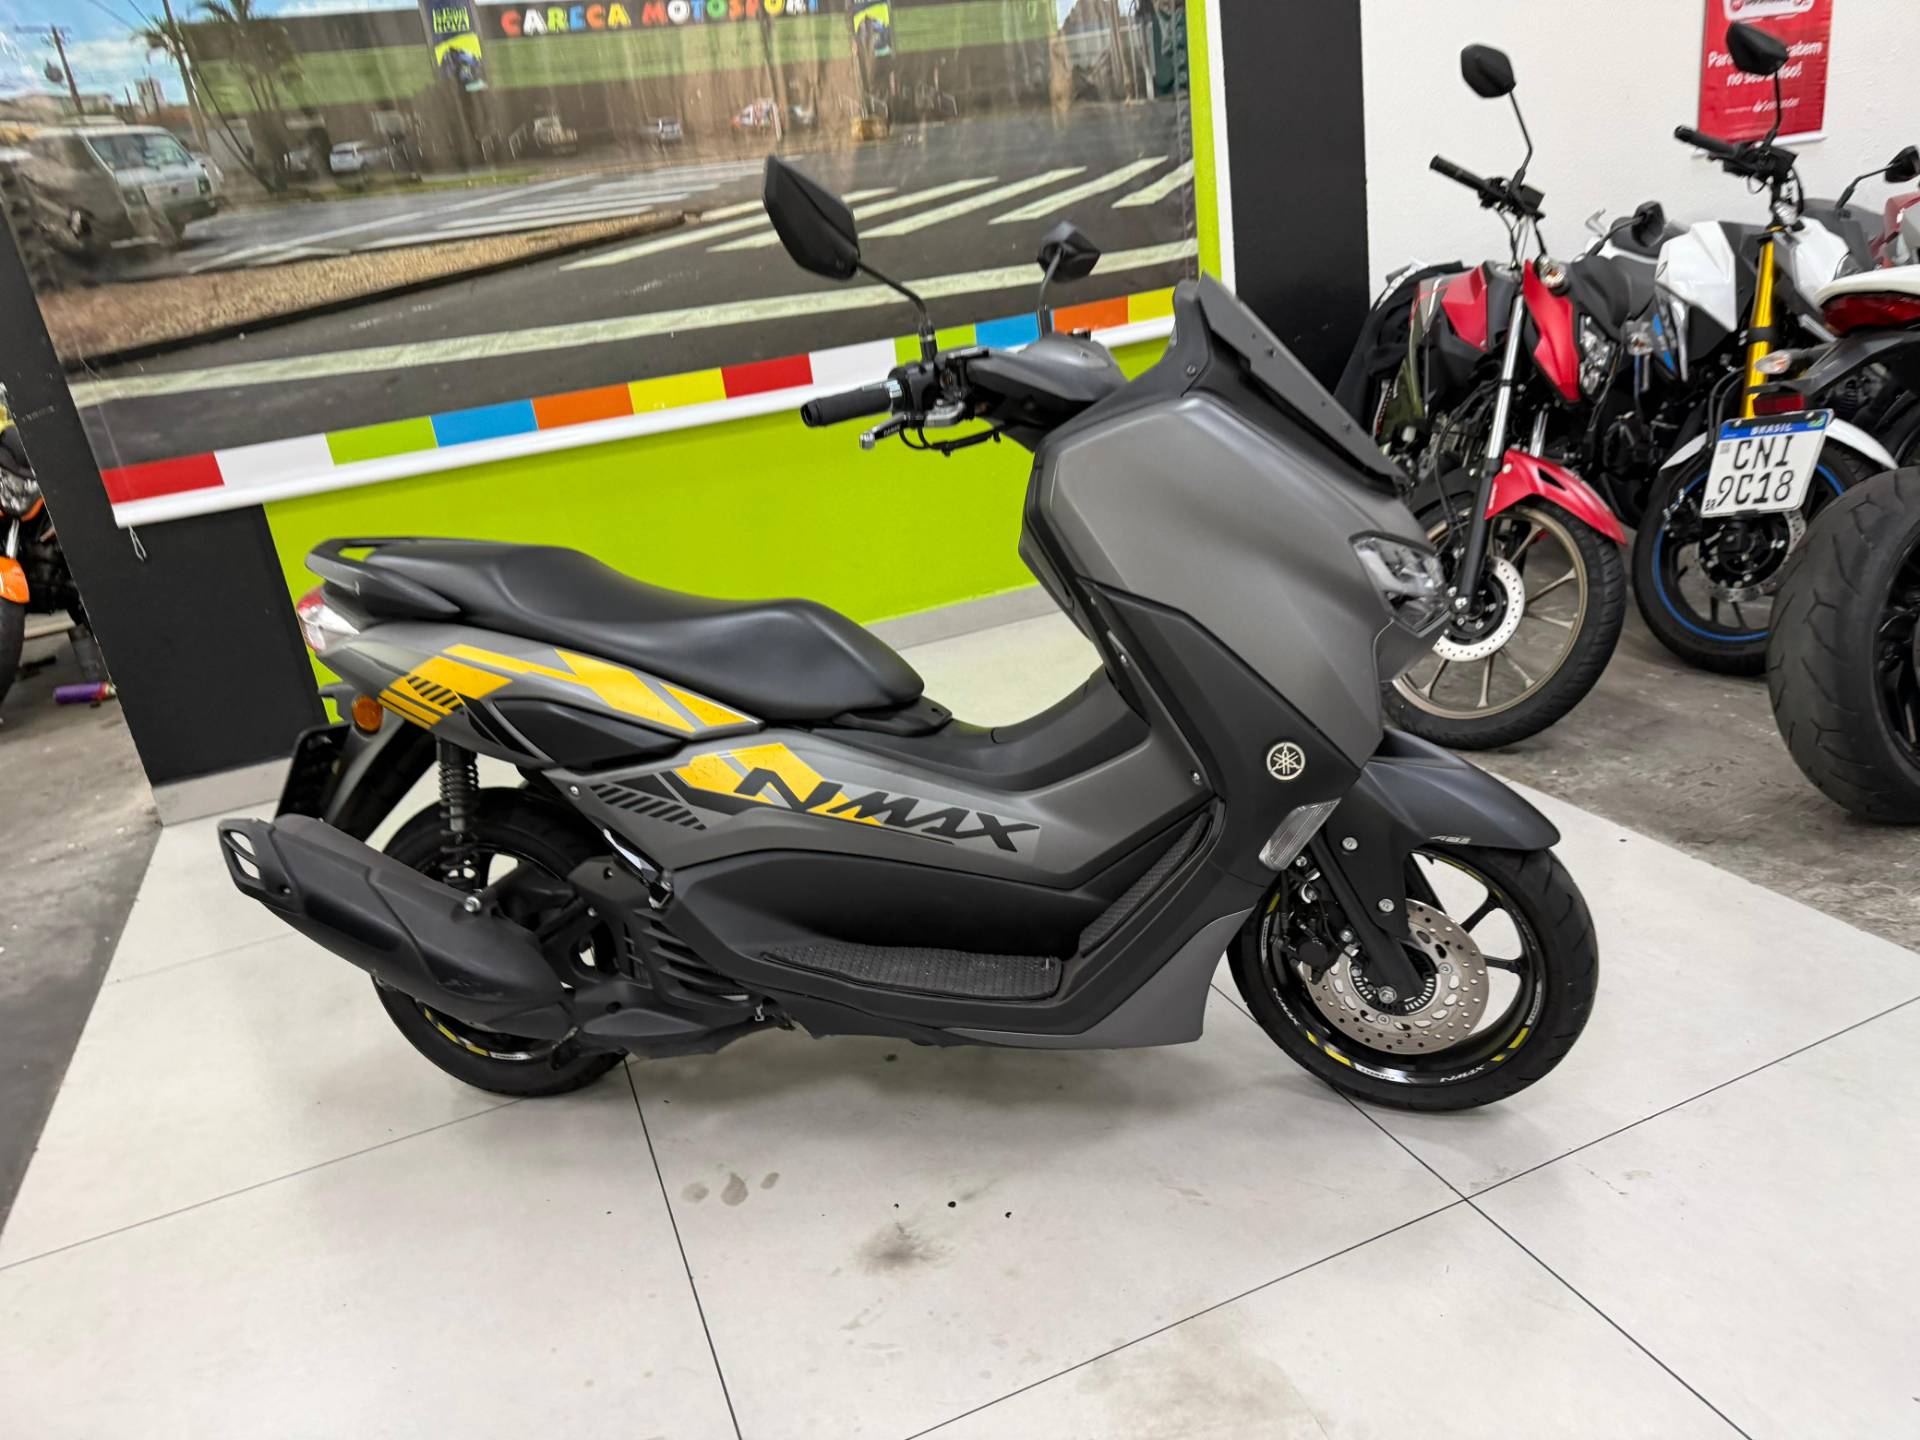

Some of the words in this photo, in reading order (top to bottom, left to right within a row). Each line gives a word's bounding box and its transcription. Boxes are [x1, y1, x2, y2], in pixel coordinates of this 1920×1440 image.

[501, 2, 631, 38] CARECA
[1750, 423, 1793, 435] BRASIL
[1733, 436, 1793, 469] CNI
[1717, 470, 1794, 507] 9C18
[733, 767, 1041, 853] NMAX
